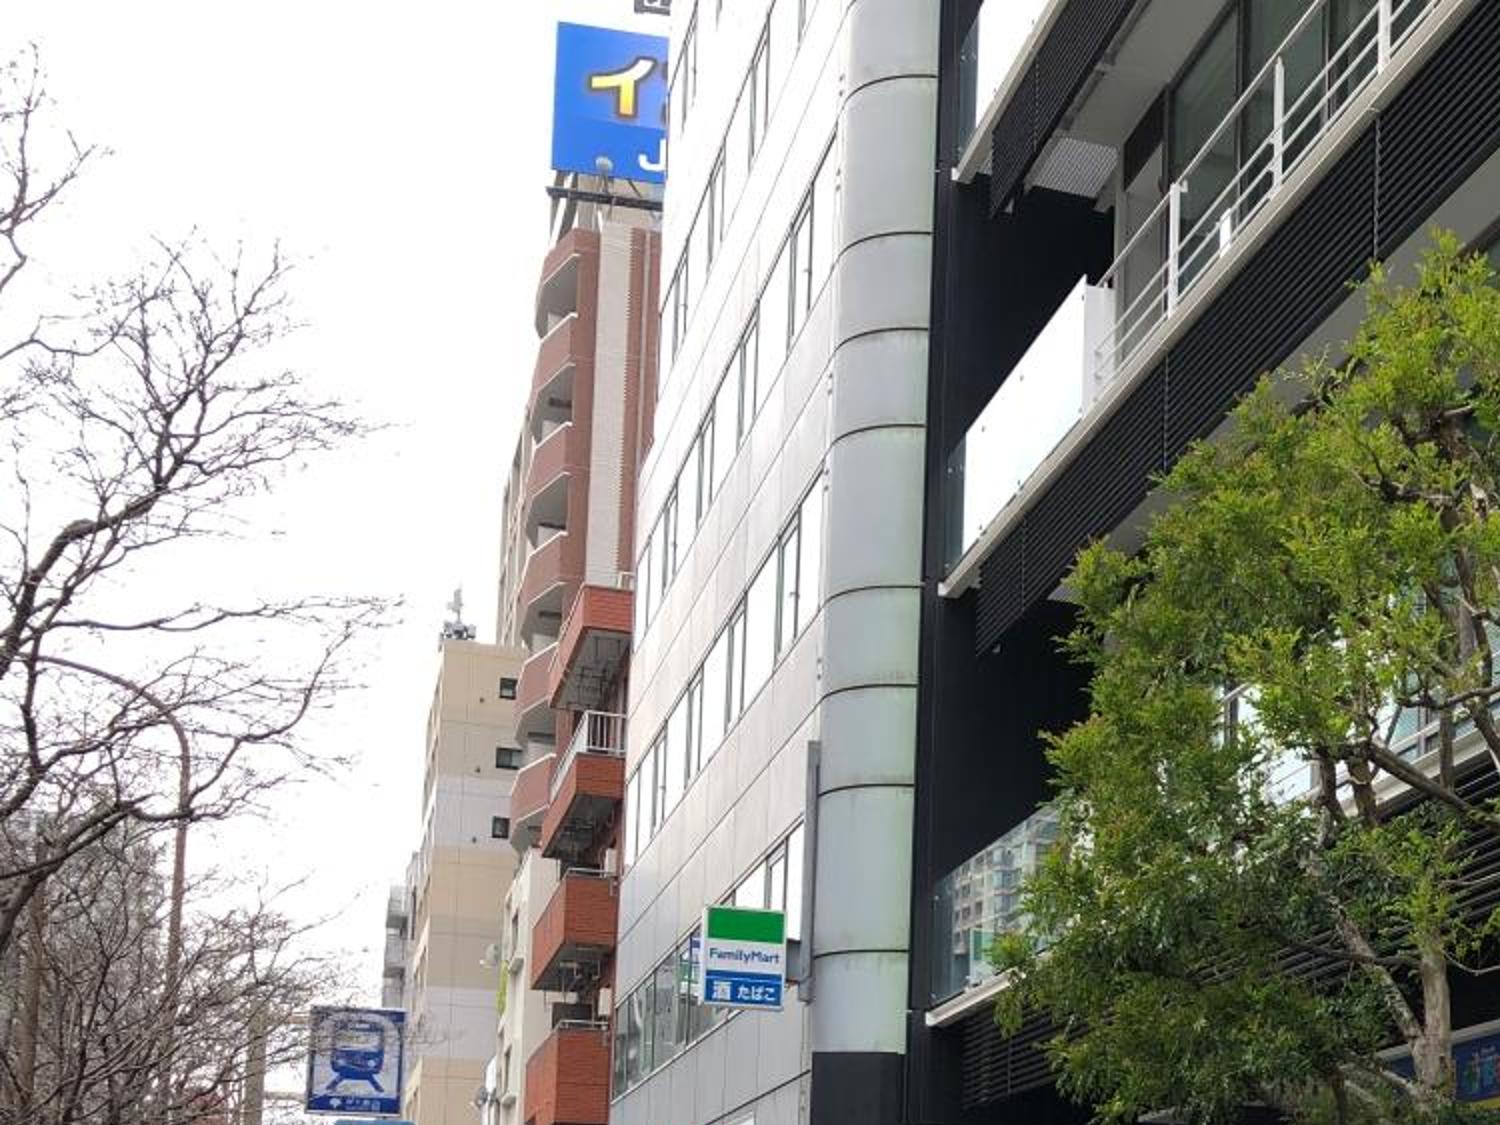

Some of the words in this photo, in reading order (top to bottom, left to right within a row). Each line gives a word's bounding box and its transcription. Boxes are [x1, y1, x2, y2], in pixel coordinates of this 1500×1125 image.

[709, 947, 779, 964] FamilyMart
[711, 980, 732, 1000] 酒
[737, 984, 776, 1001] たばこ
